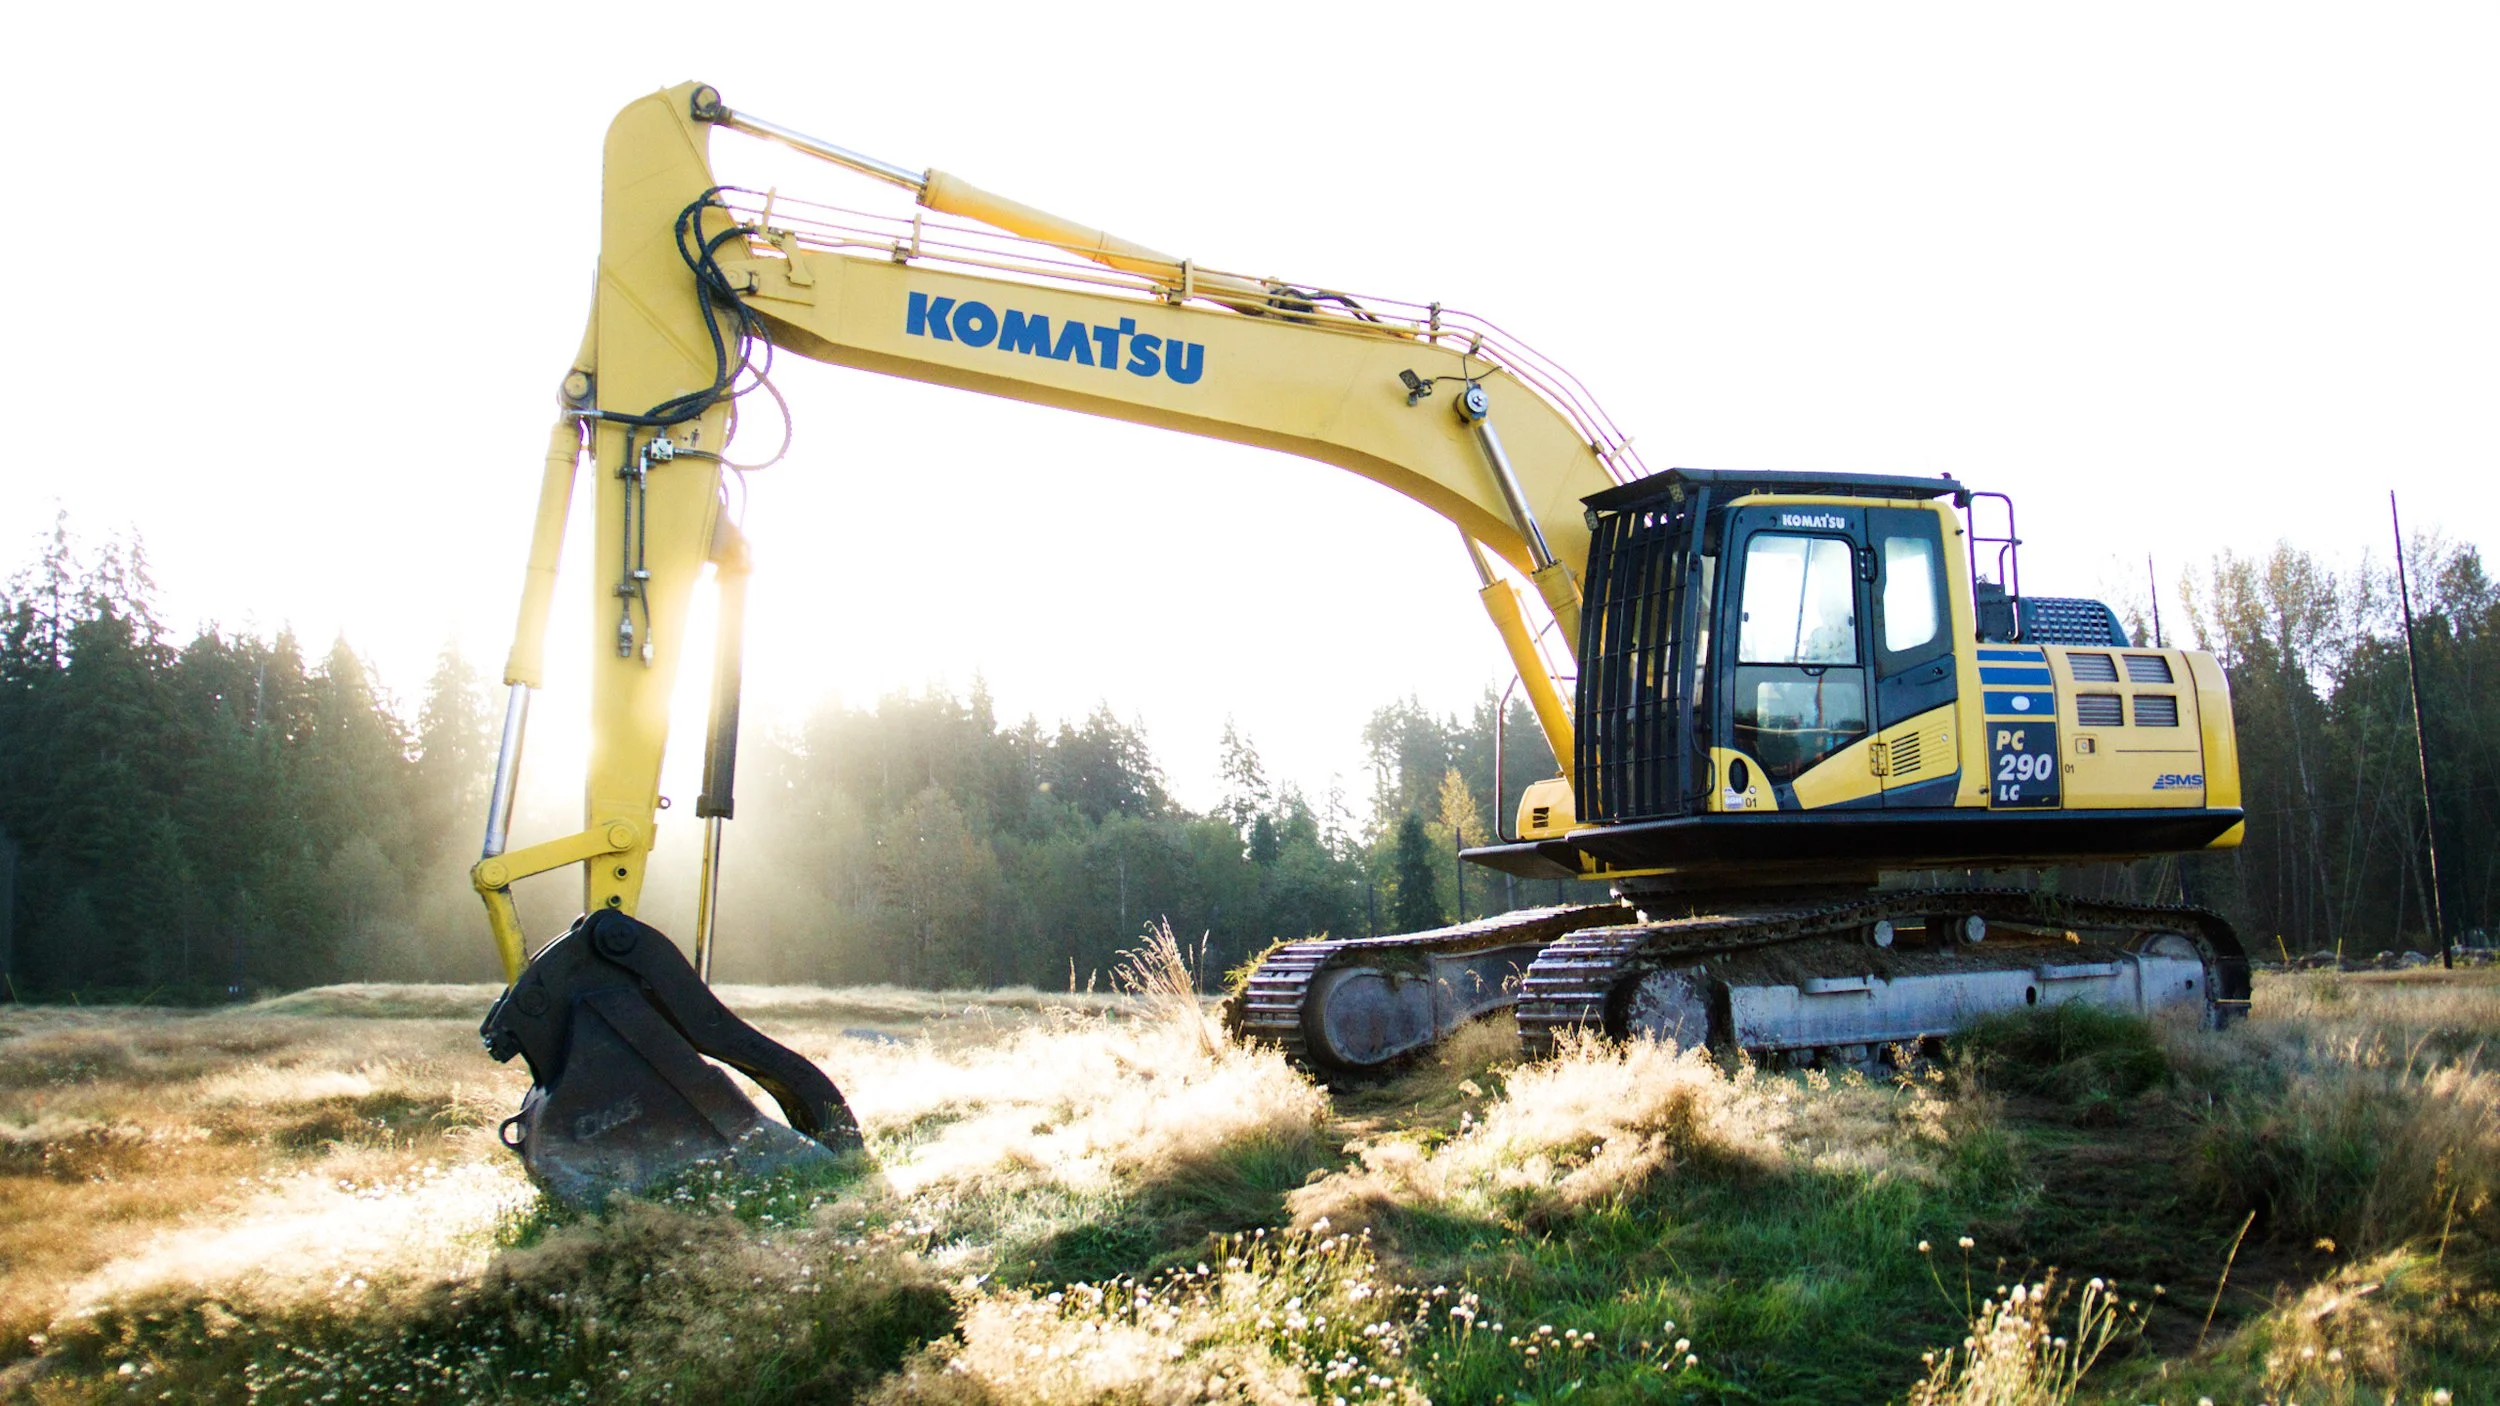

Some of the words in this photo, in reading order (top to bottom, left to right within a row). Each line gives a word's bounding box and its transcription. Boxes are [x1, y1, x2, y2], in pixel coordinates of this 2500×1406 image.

[906, 291, 1205, 384] KOMATSU
[1782, 513, 1846, 529] KOMATSU
[1996, 729, 2025, 751] PC
[1997, 753, 2053, 781] 290
[2064, 764, 2075, 773] 01
[2164, 774, 2203, 785] SMS
[1999, 784, 2020, 801] LC
[1745, 797, 1757, 808] 01
